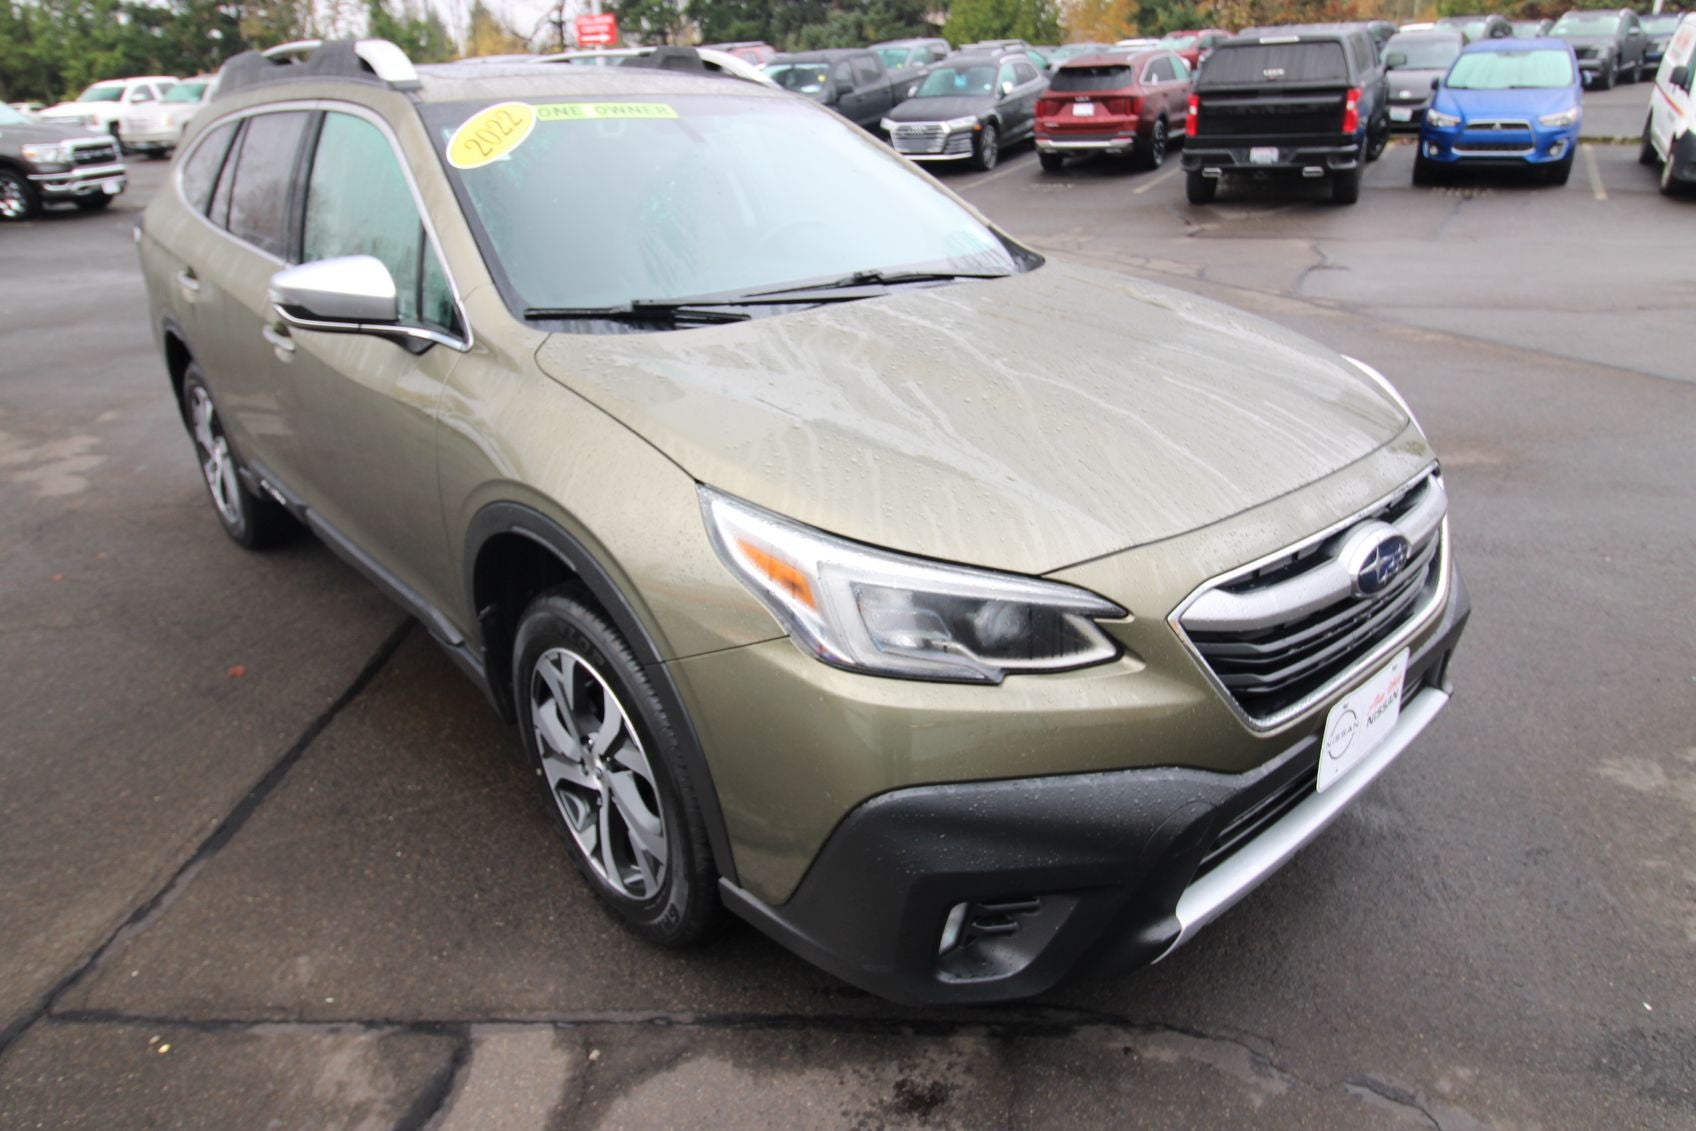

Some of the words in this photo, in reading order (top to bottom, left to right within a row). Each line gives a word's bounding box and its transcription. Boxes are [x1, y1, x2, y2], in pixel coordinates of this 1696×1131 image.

[537, 105, 583, 117] ONE
[594, 103, 670, 116] OWNER
[463, 109, 523, 157] 2022
[1366, 689, 1399, 728] NISSAN
[1325, 720, 1359, 749] NISSAN
